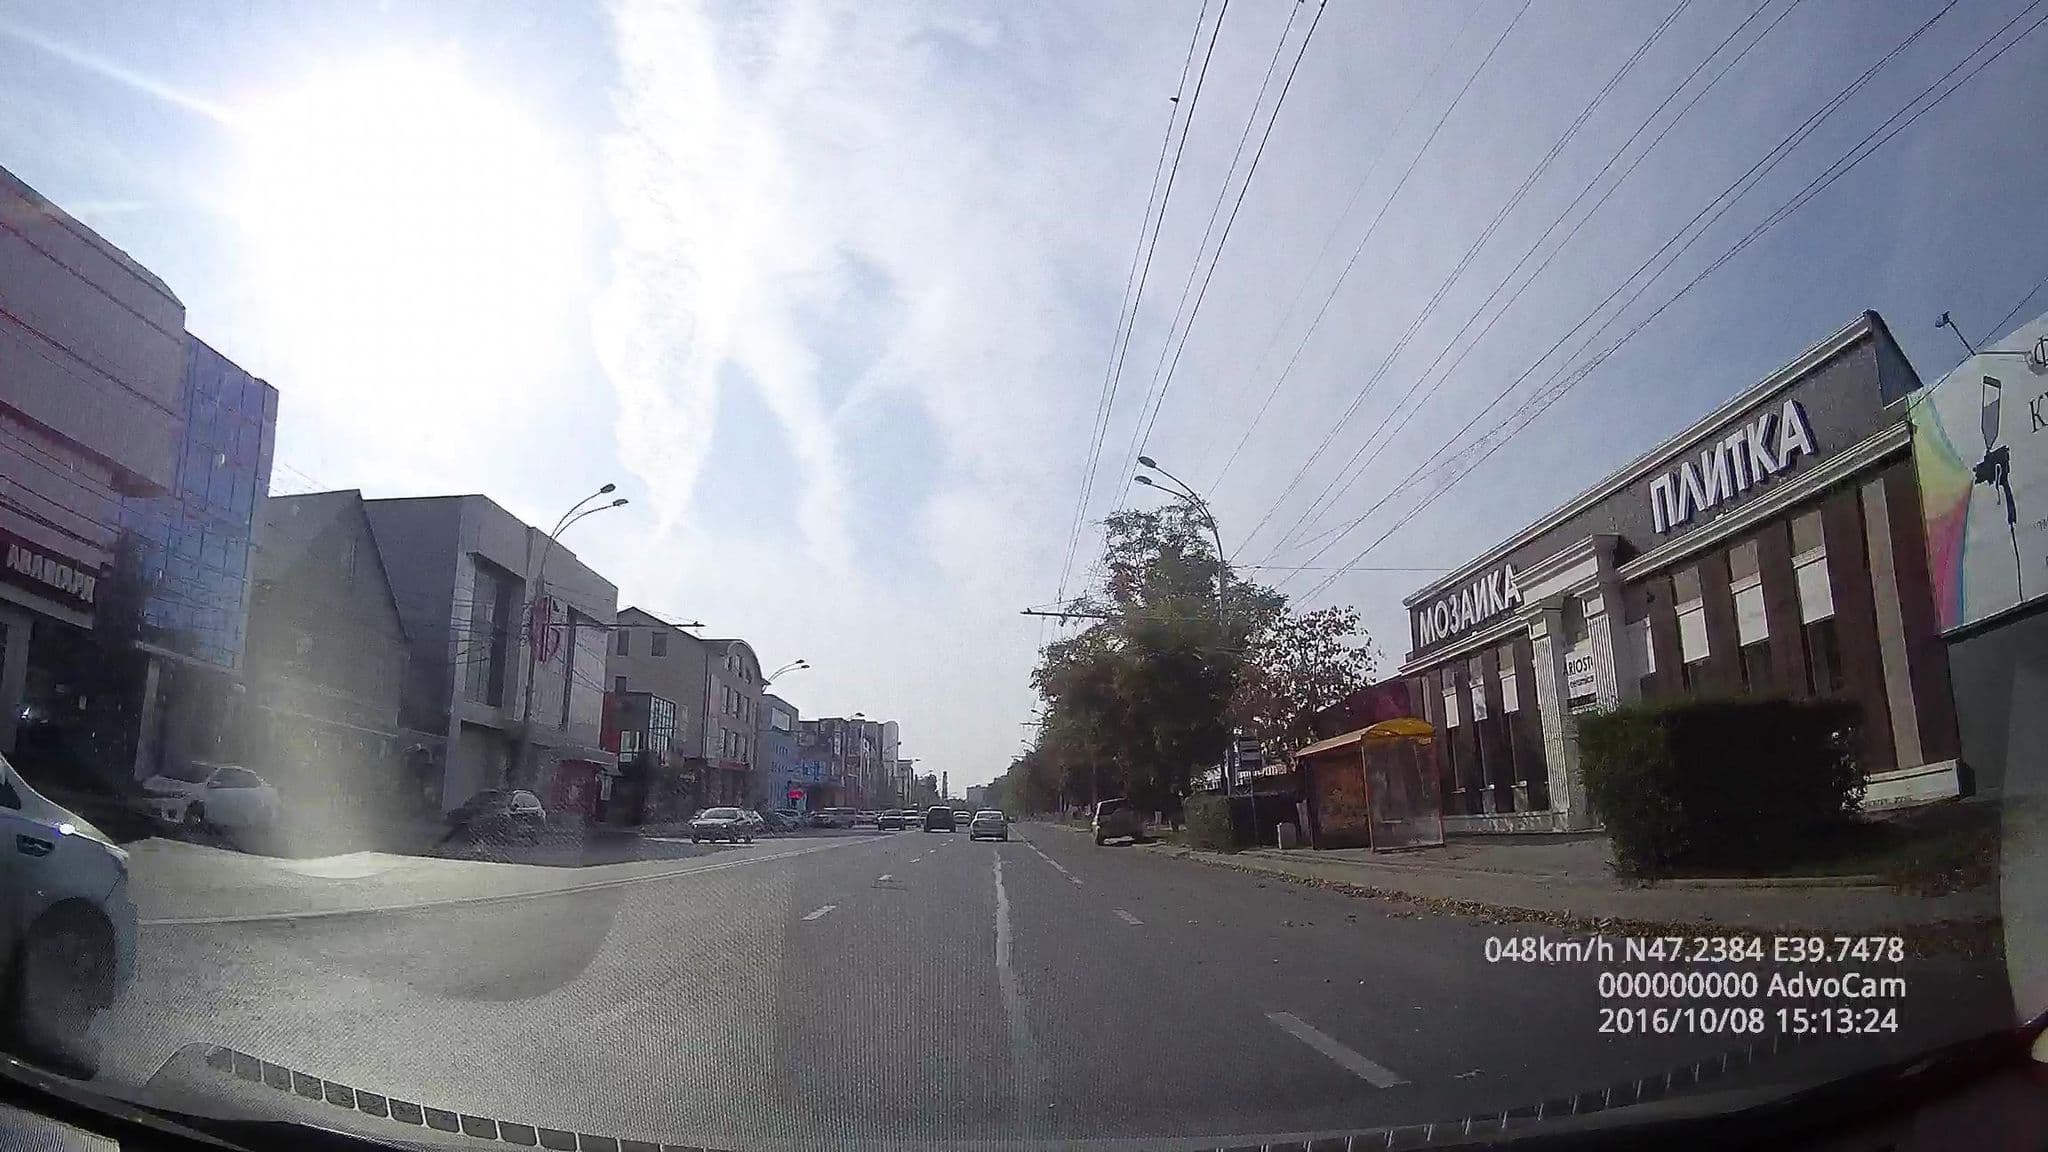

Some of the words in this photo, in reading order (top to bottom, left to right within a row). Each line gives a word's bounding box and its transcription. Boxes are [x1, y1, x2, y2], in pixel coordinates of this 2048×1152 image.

[1649, 400, 1816, 535] ПЛИТКА
[1418, 562, 1524, 648] МОЗАИКА
[1563, 655, 1594, 677] ARIOST
